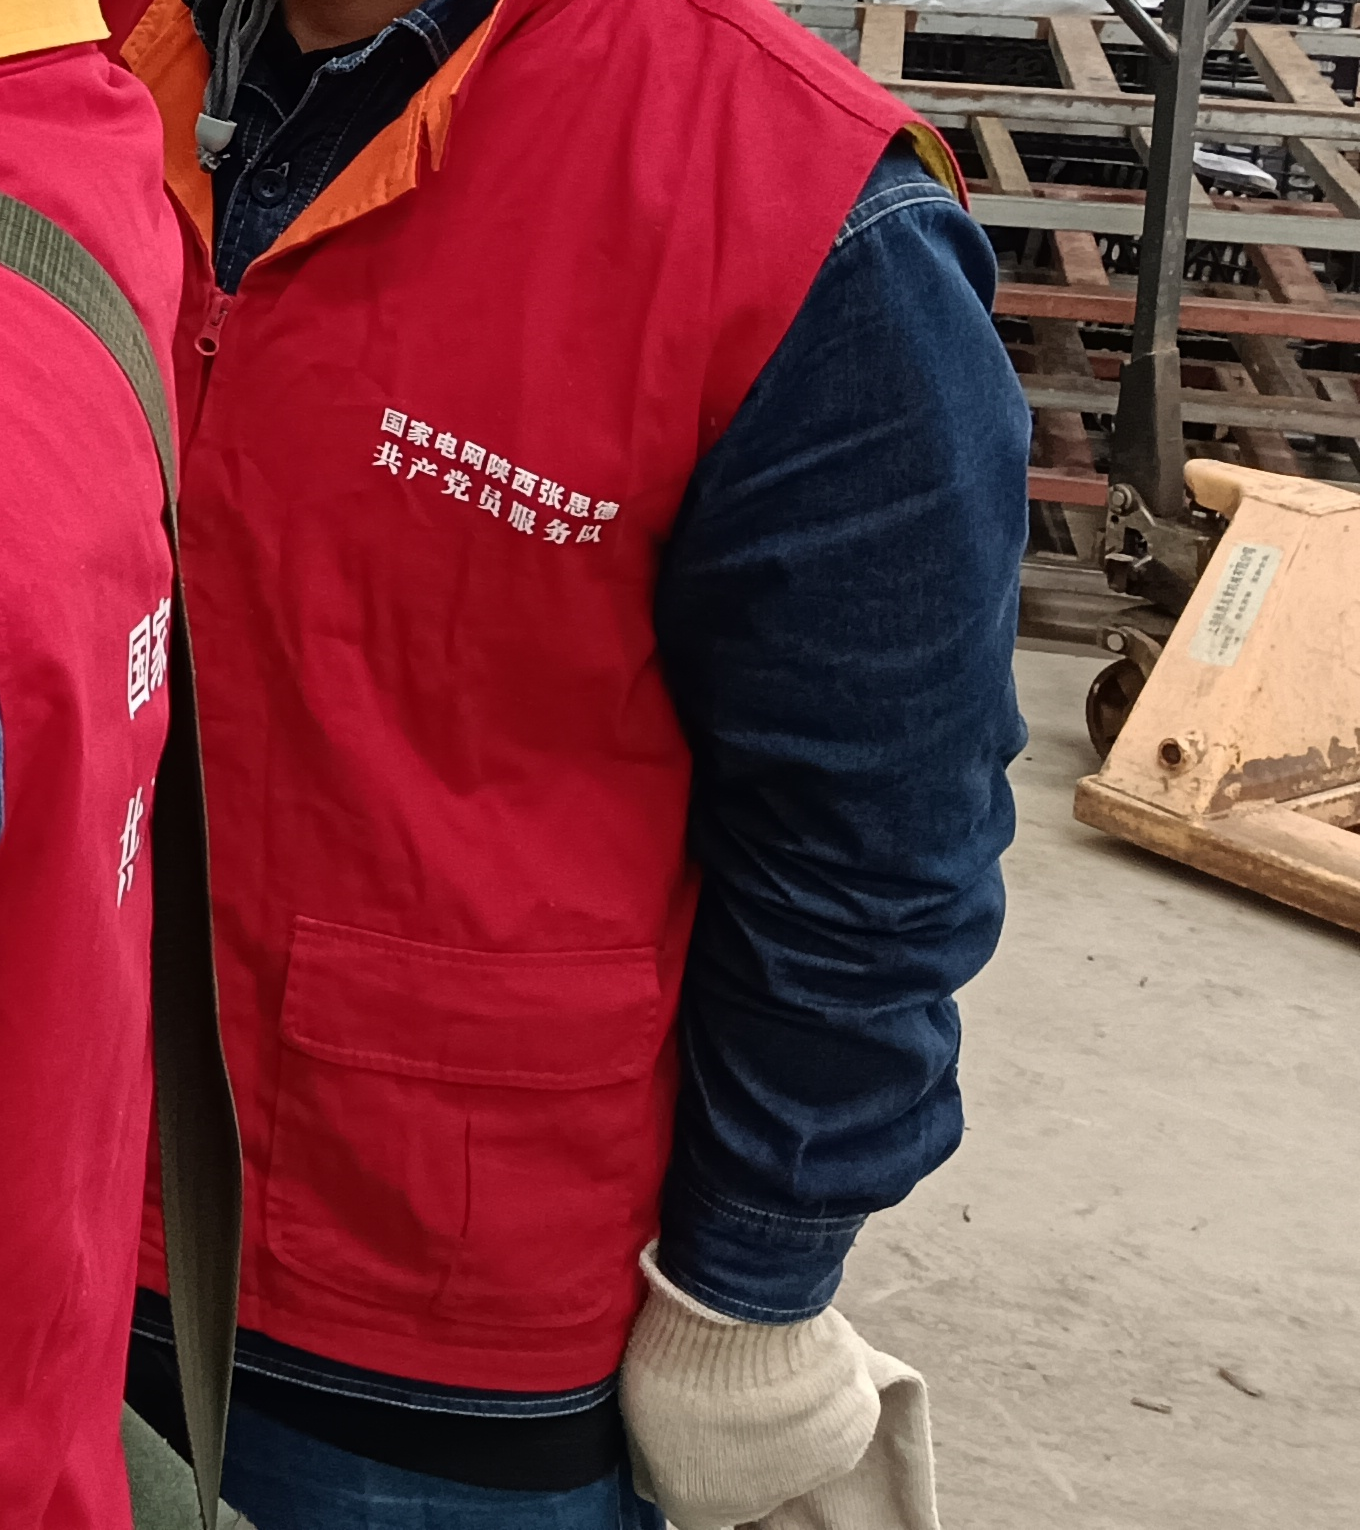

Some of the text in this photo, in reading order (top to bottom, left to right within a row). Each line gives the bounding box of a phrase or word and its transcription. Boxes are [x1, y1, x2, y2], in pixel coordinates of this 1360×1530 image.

[371, 440, 603, 545] 共产党员服务队
[380, 407, 620, 521] 国家电网陕西张思德
[127, 597, 171, 720] 国家
